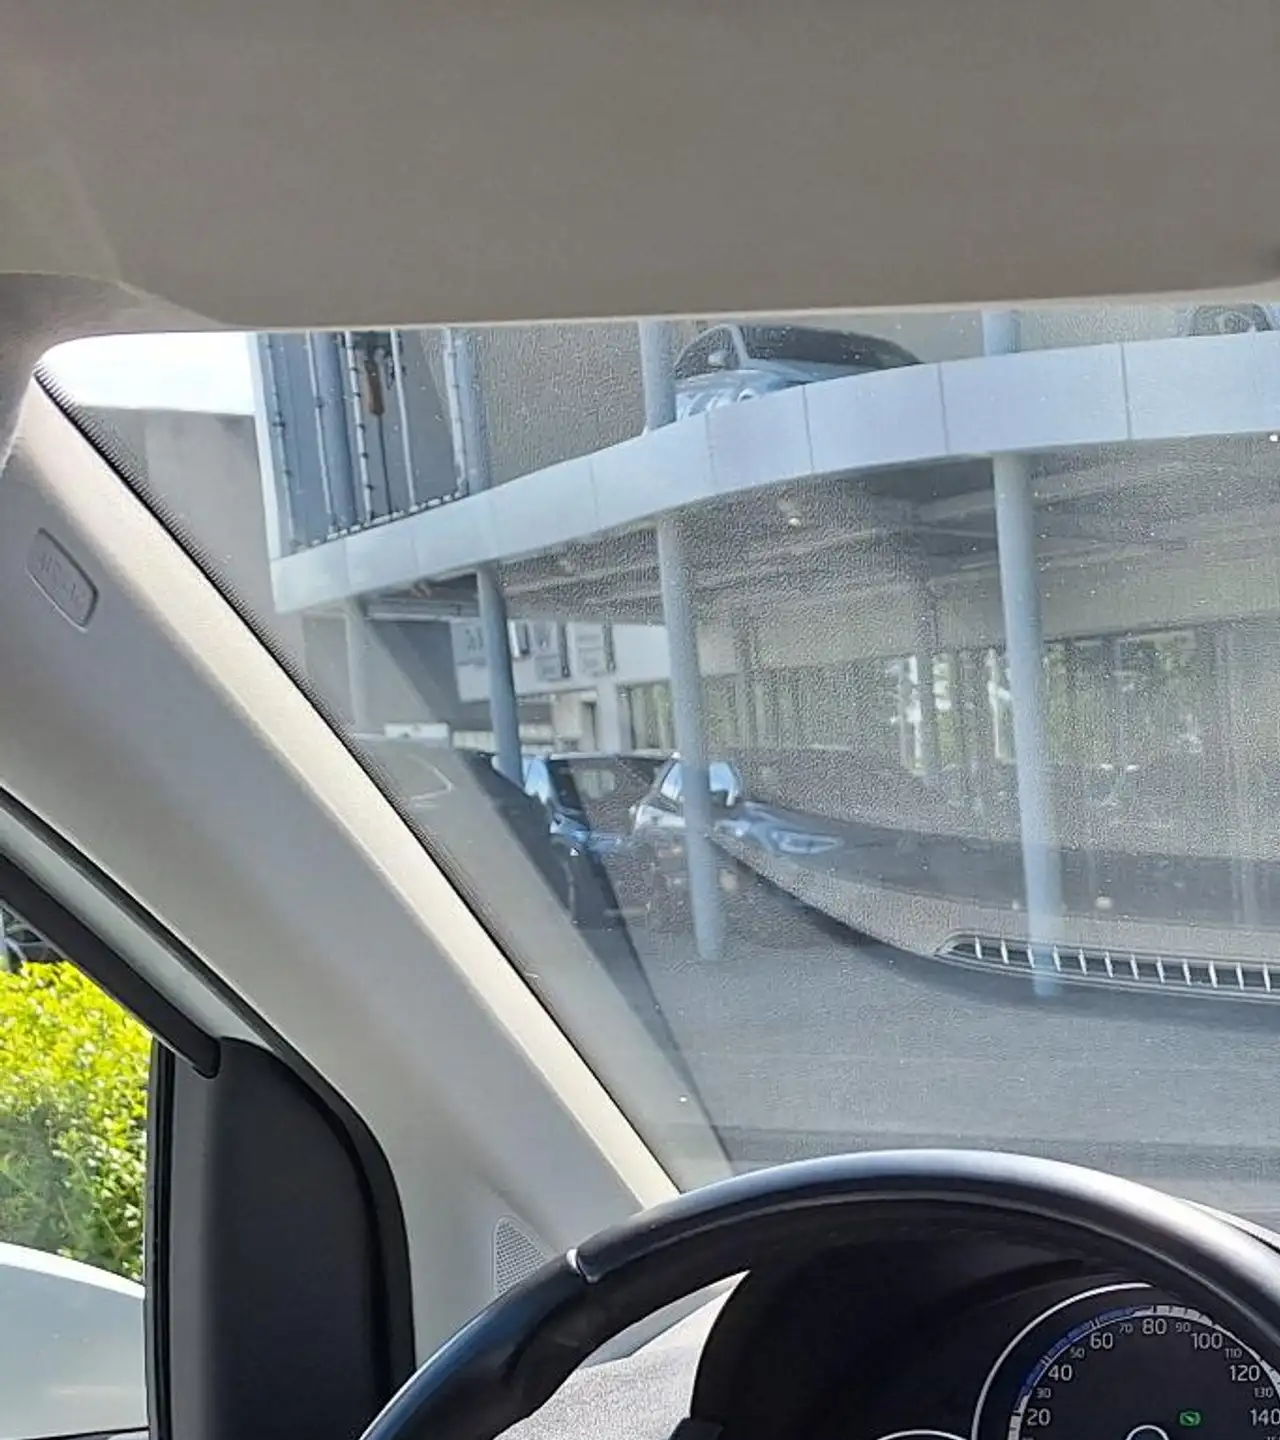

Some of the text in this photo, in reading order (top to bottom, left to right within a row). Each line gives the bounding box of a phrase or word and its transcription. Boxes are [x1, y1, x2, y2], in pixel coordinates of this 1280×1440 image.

[1119, 1323, 1132, 1334] 70
[1143, 1319, 1167, 1335] 80
[1175, 1322, 1190, 1333] 90
[1090, 1333, 1113, 1350] 60
[1191, 1333, 1223, 1350] 100
[1070, 1347, 1085, 1359] 50
[1225, 1348, 1241, 1359] 110
[1048, 1364, 1072, 1381] 40
[1230, 1364, 1260, 1381] 120
[1036, 1388, 1051, 1399] 30
[1254, 1387, 1273, 1398] 130
[1026, 1408, 1050, 1425] 20
[1250, 1408, 1280, 1425] 140
